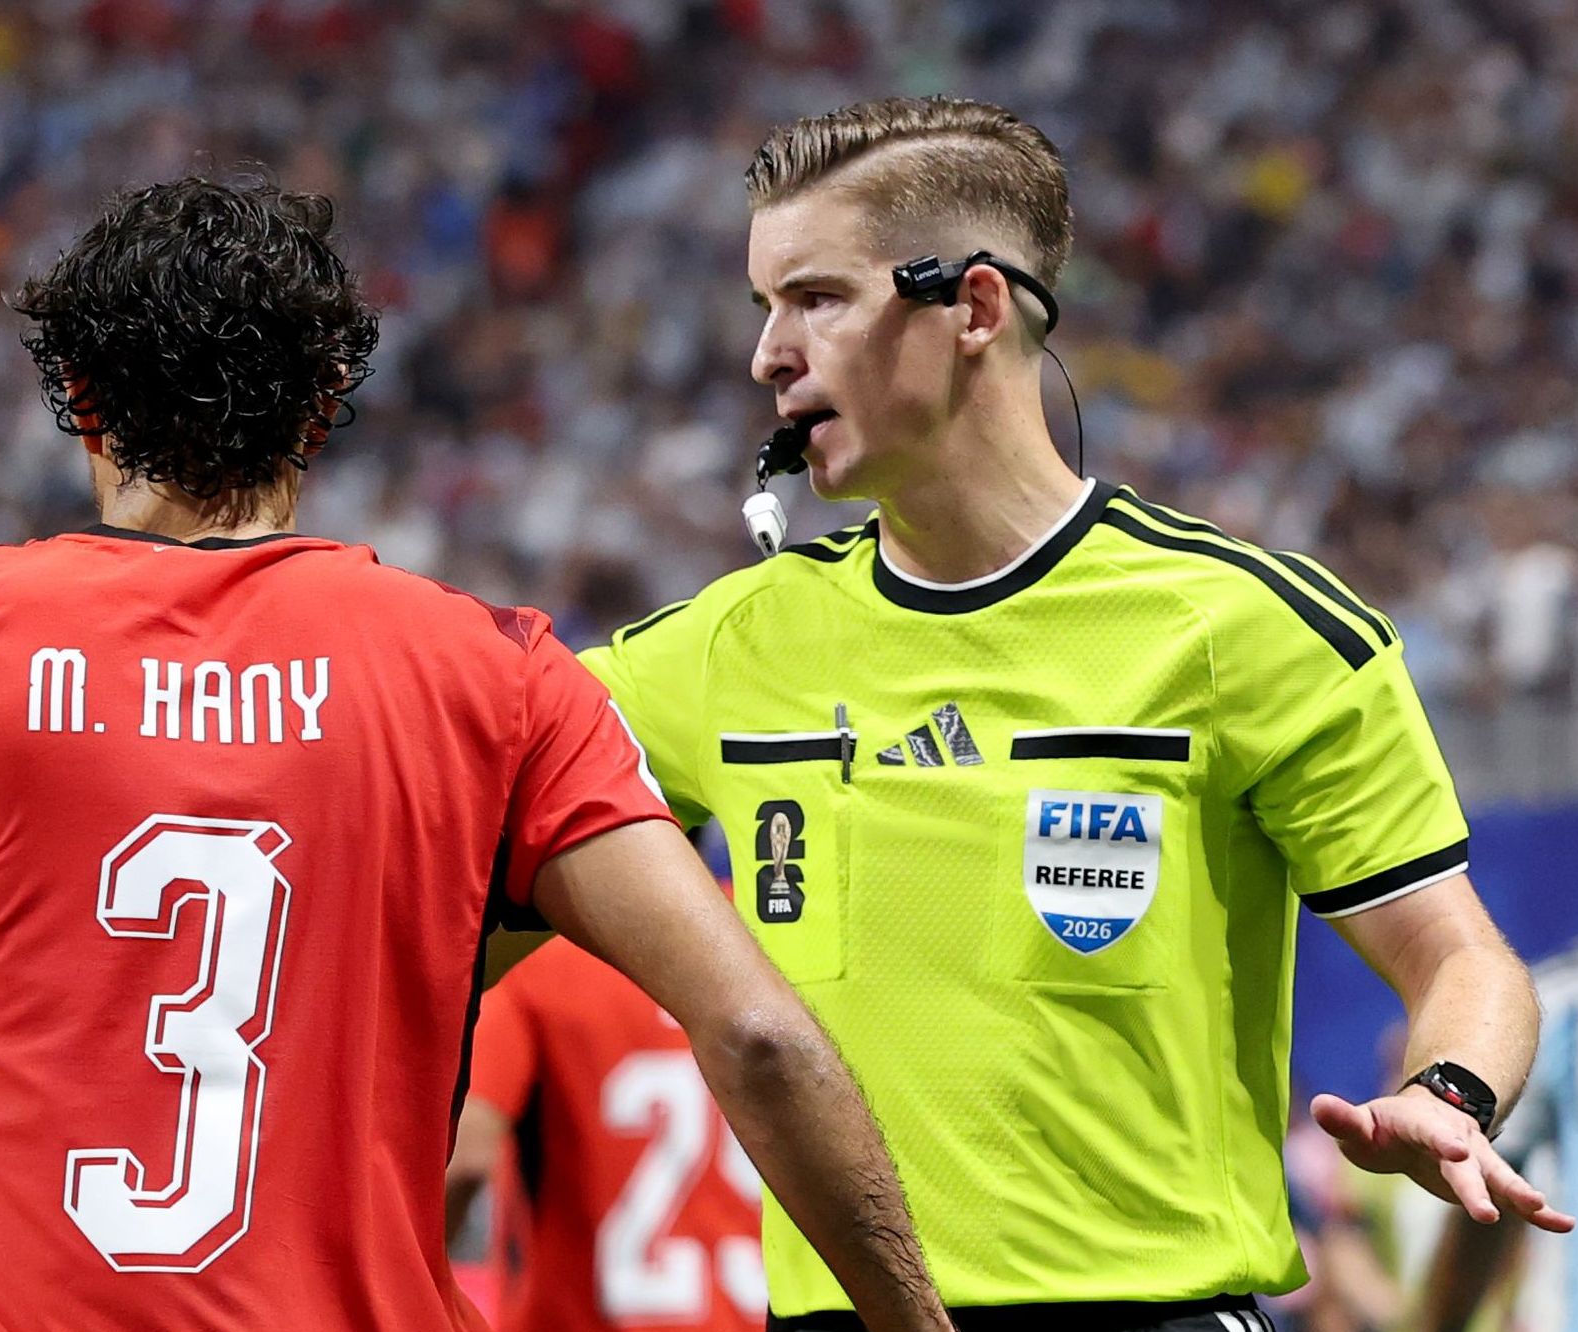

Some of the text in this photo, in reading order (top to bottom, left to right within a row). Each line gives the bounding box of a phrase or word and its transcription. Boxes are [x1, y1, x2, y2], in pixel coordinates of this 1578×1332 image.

[914, 267, 940, 281] Lenovo
[27, 647, 330, 744] M. HANY
[1038, 801, 1148, 843] FIFA
[1036, 865, 1145, 890] REFEREE
[768, 898, 792, 914] FIFA
[1062, 919, 1112, 940] 2026
[64, 813, 293, 1274] 3
